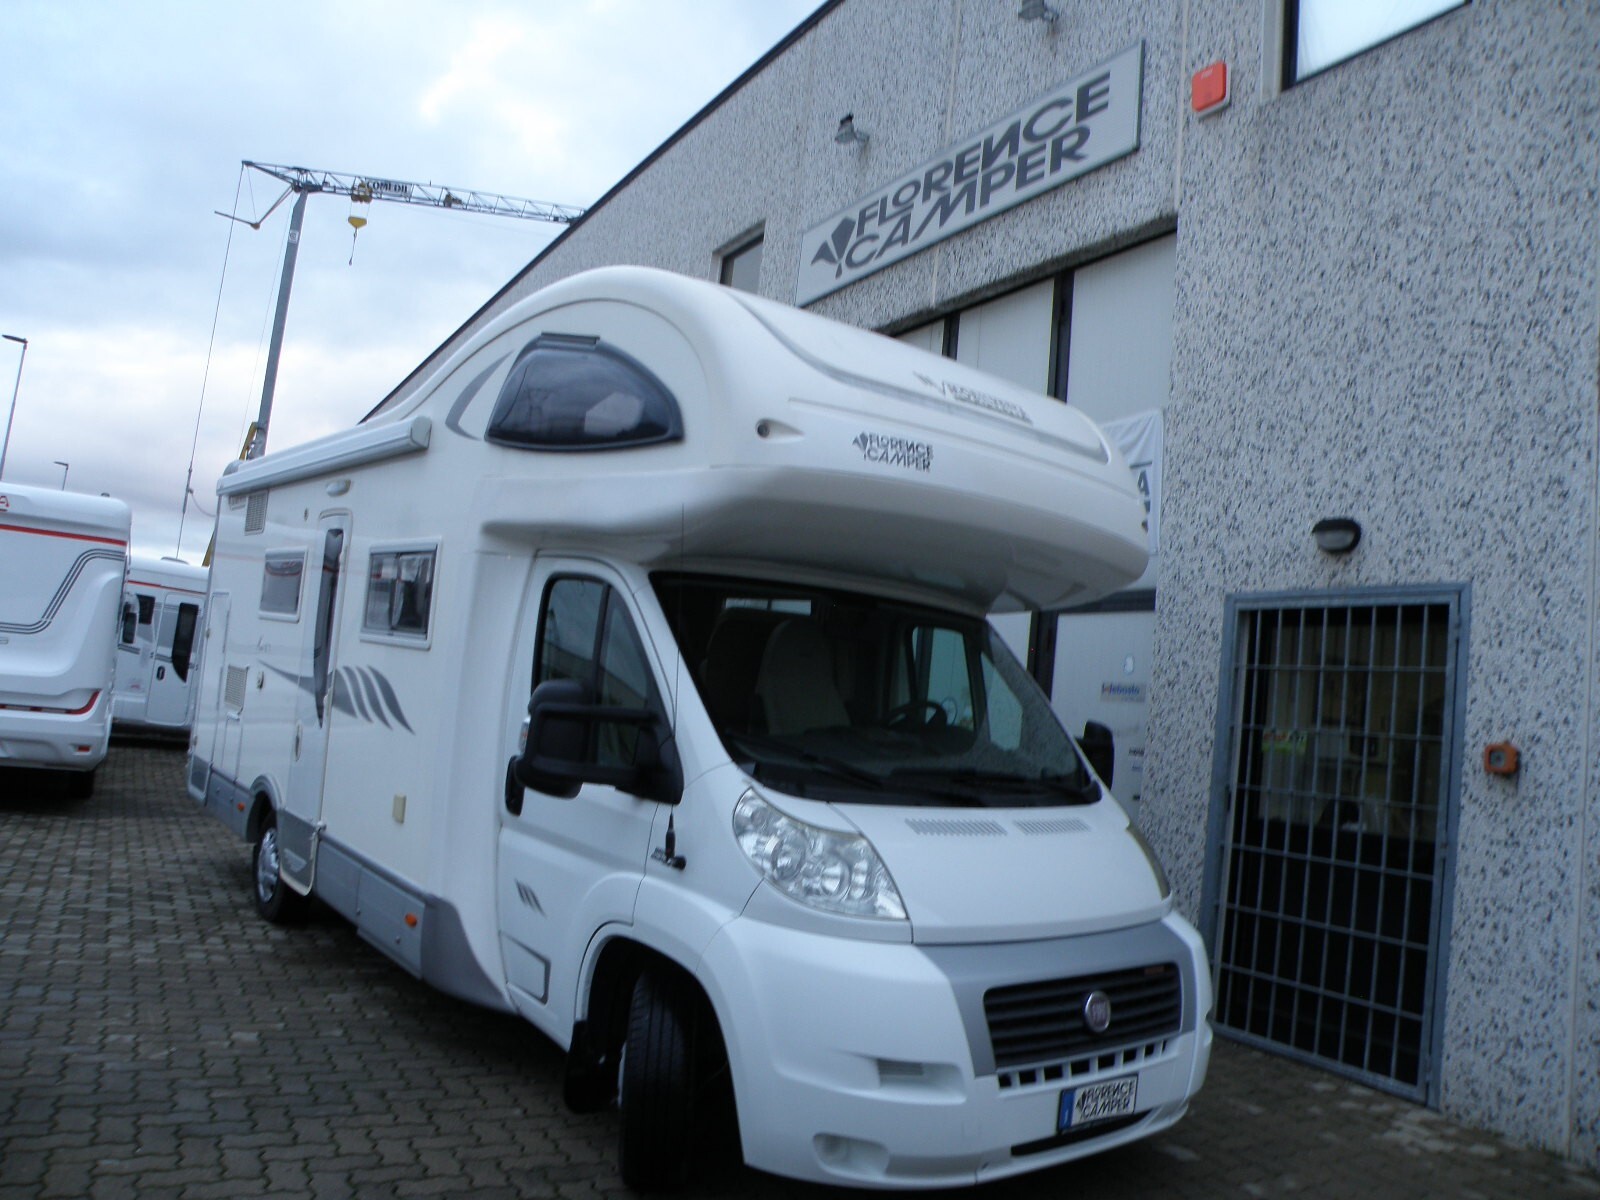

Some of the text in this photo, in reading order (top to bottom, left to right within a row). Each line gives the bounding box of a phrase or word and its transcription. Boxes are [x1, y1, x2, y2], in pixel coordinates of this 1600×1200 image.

[845, 125, 1091, 270] CAMPER
[856, 71, 1111, 238] FLORENCE
[867, 447, 931, 472] CAMPER
[868, 432, 934, 460] FLORENCE
